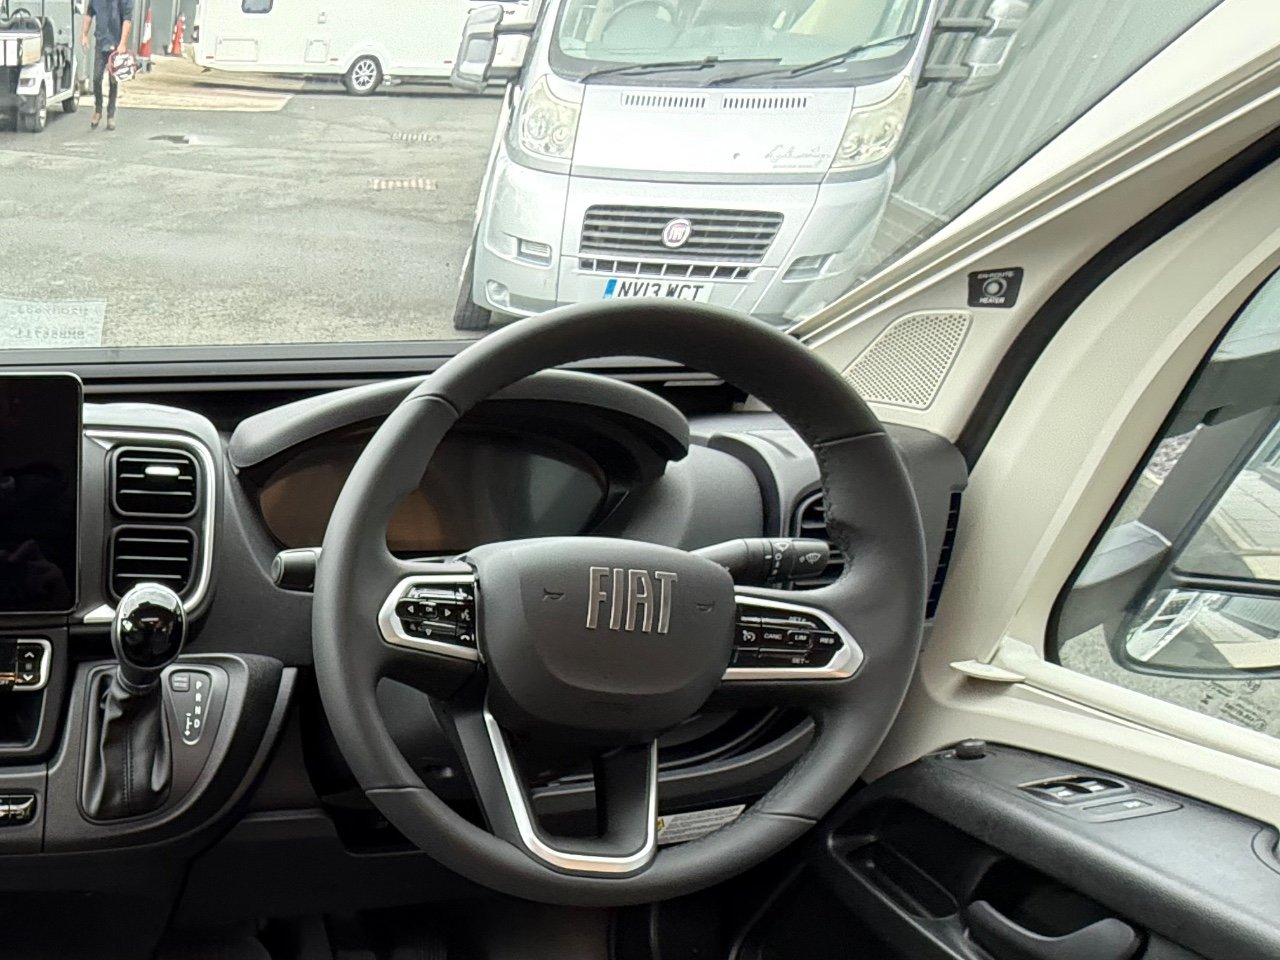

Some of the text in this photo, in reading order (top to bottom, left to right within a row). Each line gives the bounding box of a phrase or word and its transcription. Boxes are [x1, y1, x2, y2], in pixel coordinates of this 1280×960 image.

[617, 281, 662, 298] NV13
[586, 566, 679, 634] FIAT
[763, 632, 782, 640] CANC
[195, 680, 203, 690] P
[195, 692, 202, 702] R
[194, 705, 202, 715] N
[193, 718, 201, 729] D
